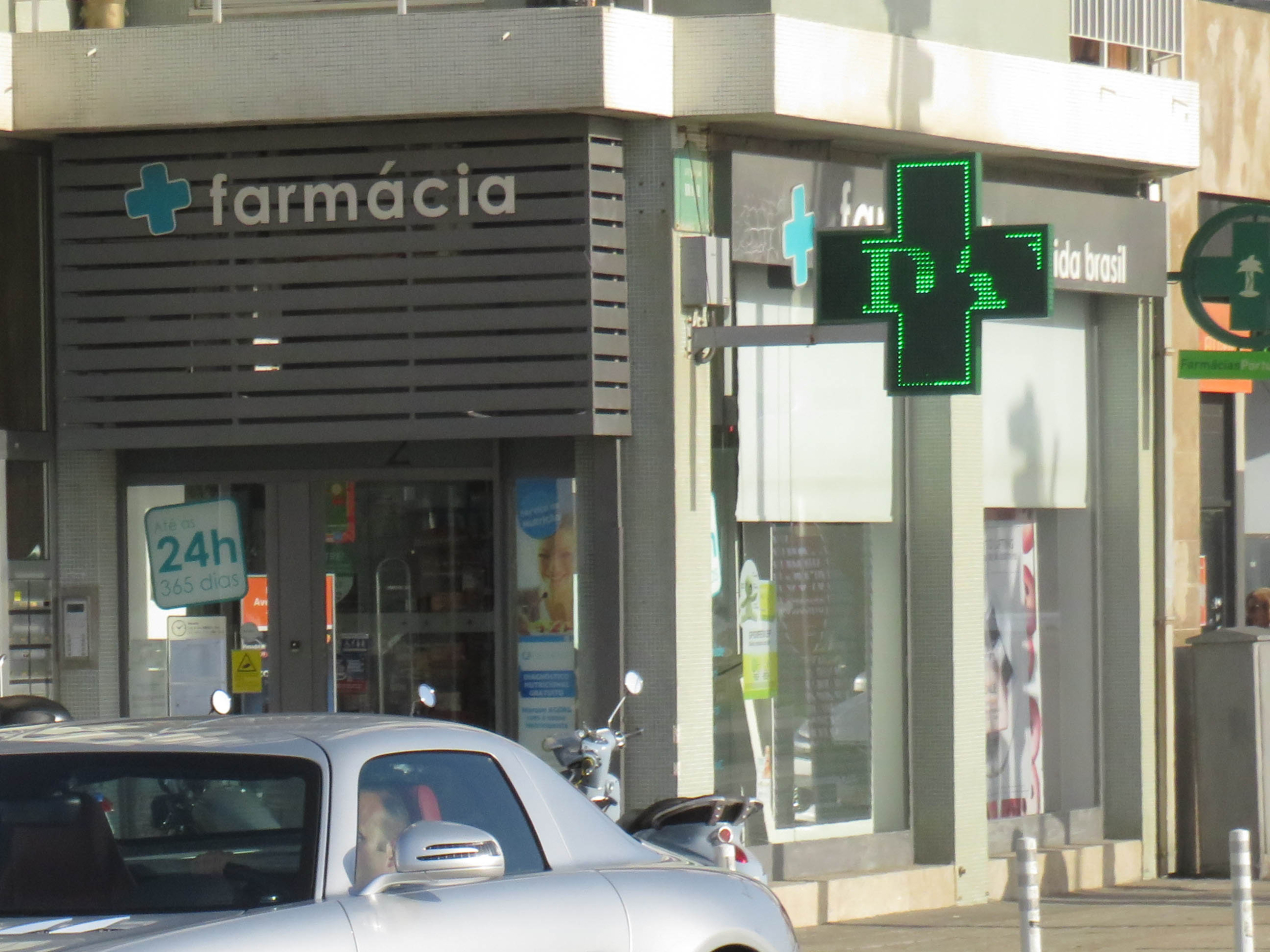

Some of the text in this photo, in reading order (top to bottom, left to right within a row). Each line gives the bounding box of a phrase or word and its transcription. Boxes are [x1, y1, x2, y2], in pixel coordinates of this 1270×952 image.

[209, 160, 517, 226] farmácia
[1084, 242, 1128, 284] brasil
[157, 529, 238, 573] 24h
[160, 572, 240, 597] 365 dias
